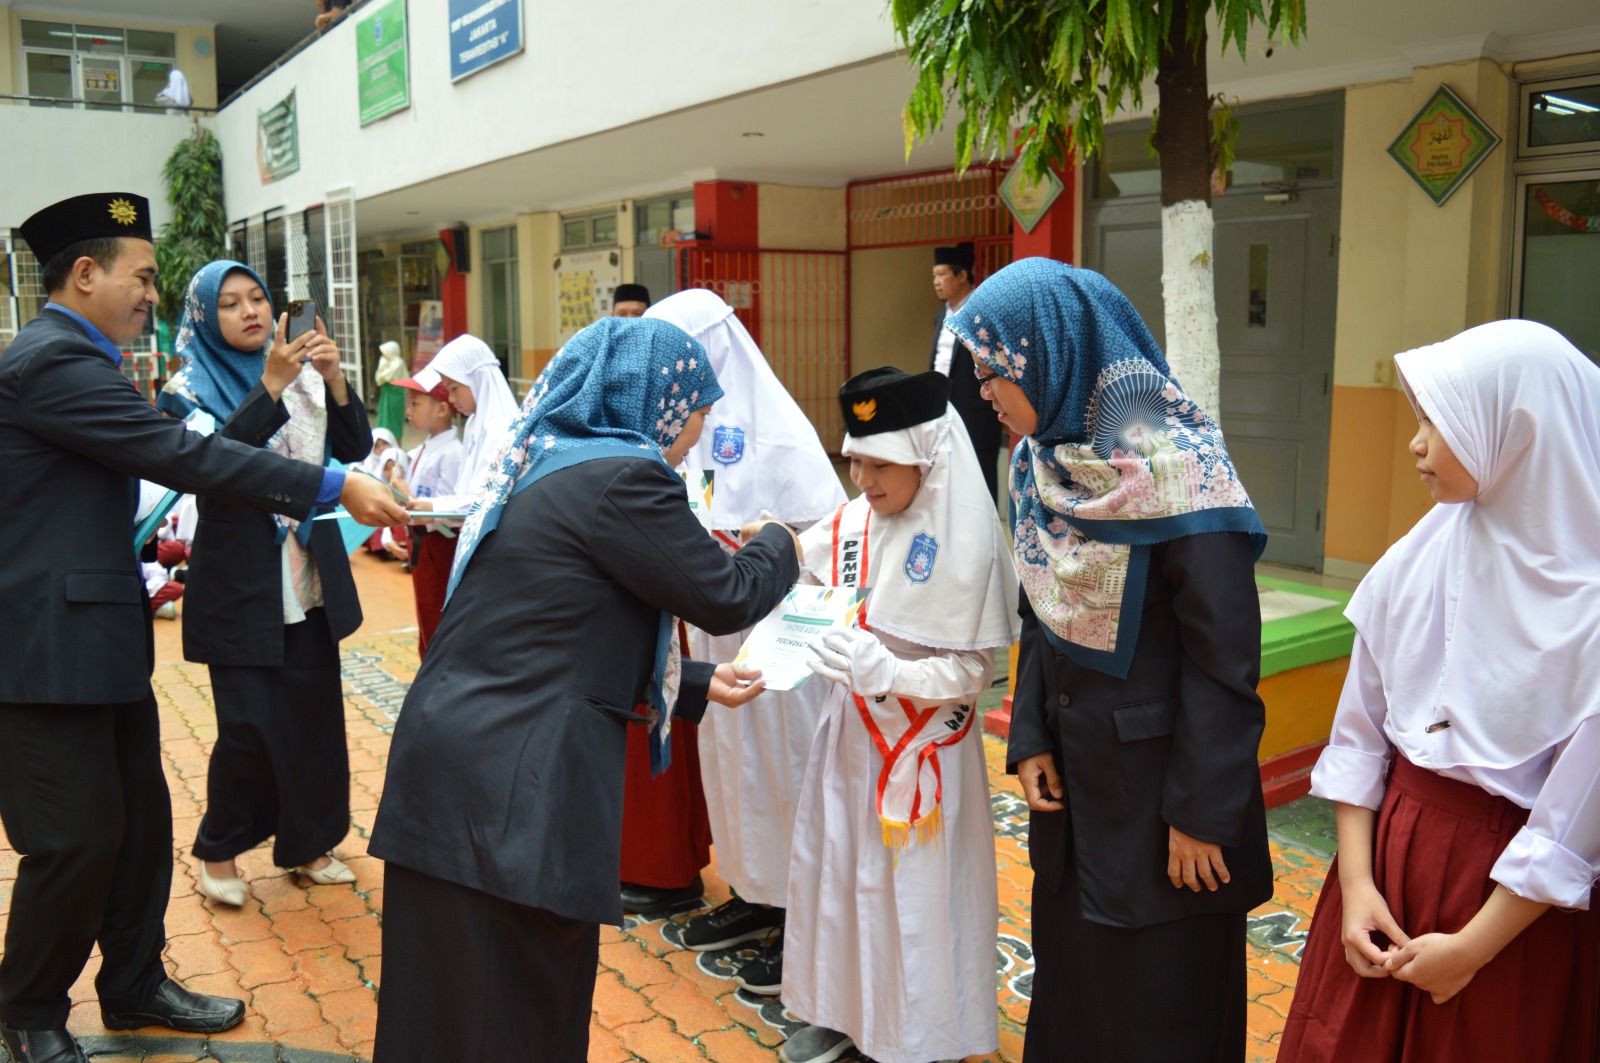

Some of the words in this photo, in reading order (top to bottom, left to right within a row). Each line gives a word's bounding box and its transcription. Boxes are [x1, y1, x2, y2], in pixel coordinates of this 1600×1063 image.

[469, 17, 497, 42] JAKARTA
[843, 540, 859, 587] PEMB
[776, 636, 808, 648] PERINGKAT
